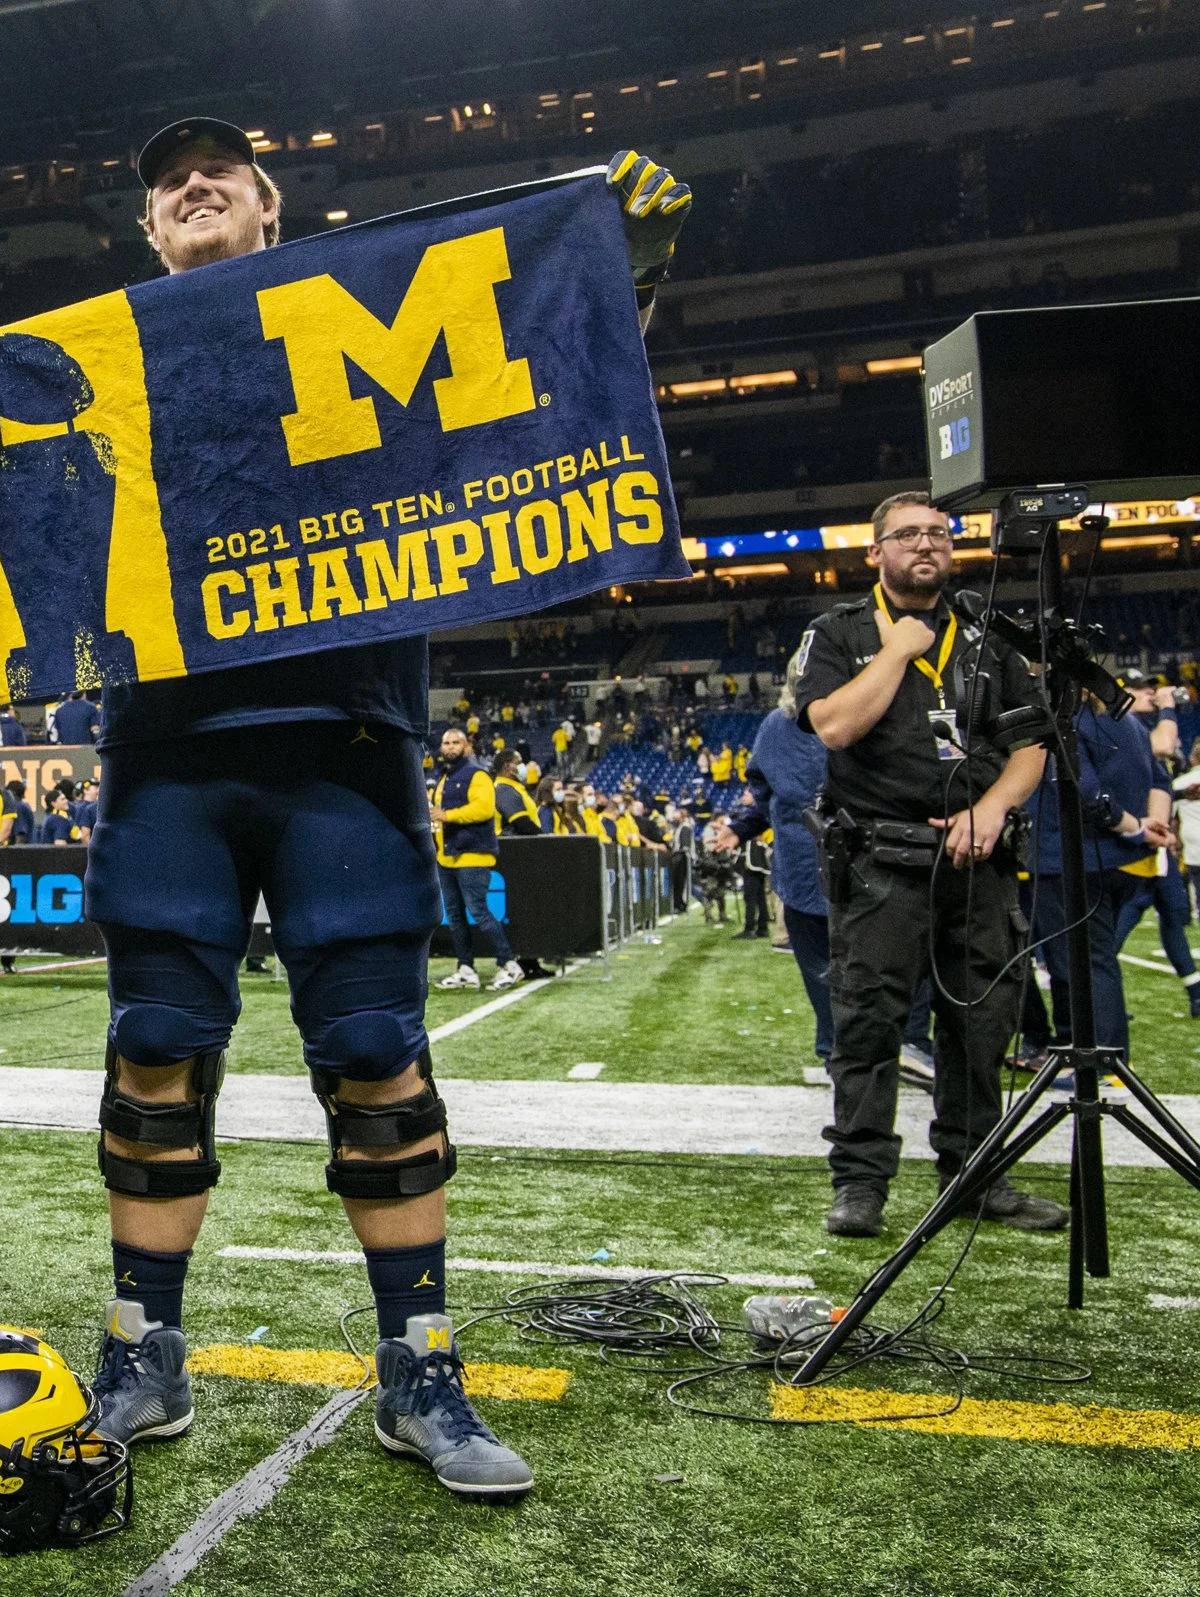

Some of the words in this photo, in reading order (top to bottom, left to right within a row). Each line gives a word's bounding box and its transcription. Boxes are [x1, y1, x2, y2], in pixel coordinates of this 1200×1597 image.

[200, 470, 666, 641] CHAMPIONS
[205, 524, 291, 564] 2021
[298, 508, 365, 545] BIG
[463, 434, 646, 508] FOOTBALL
[425, 1326, 450, 1350] M
